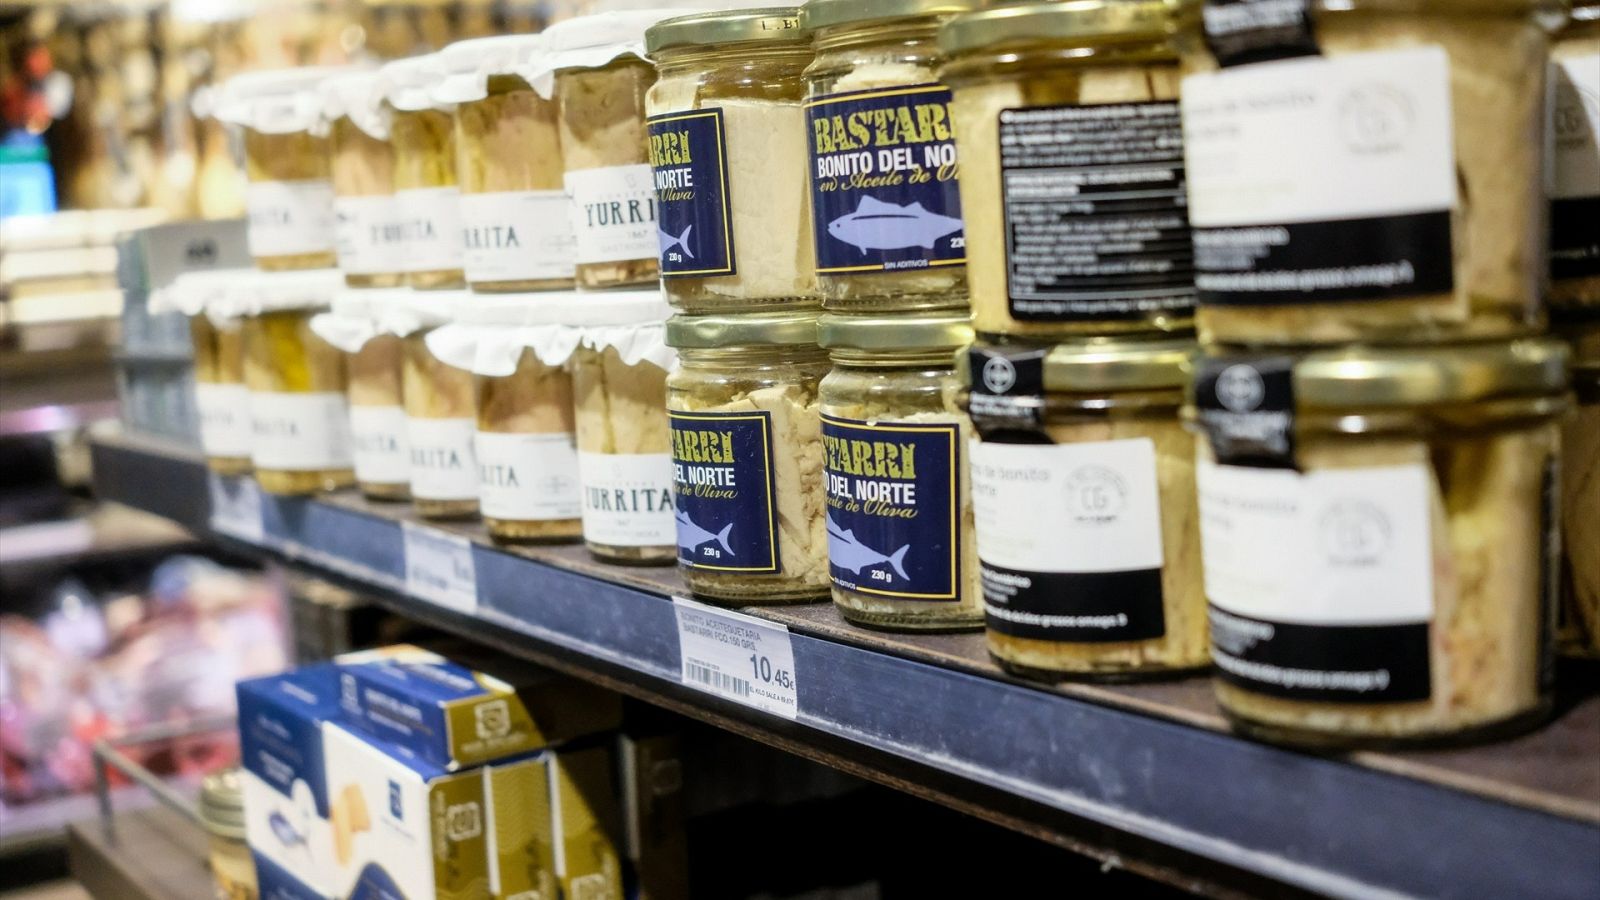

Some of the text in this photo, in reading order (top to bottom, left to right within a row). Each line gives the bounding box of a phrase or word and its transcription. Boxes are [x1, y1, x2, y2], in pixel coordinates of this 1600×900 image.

[818, 144, 956, 178] BONITO DEL NO
[656, 168, 693, 190] NORTE
[842, 169, 903, 191] Aceite
[909, 164, 931, 183] de
[937, 162, 960, 182] O
[669, 253, 678, 262] 230
[884, 258, 928, 270] SIN ADITIVOS
[688, 466, 736, 487] NORTE
[694, 481, 738, 499] Oliva
[831, 474, 853, 498] DEL
[855, 479, 916, 504] NORTE
[845, 497, 860, 512] de
[863, 498, 918, 518] Oliva
[704, 547, 721, 559] 230 g
[871, 569, 892, 583] 230 g
